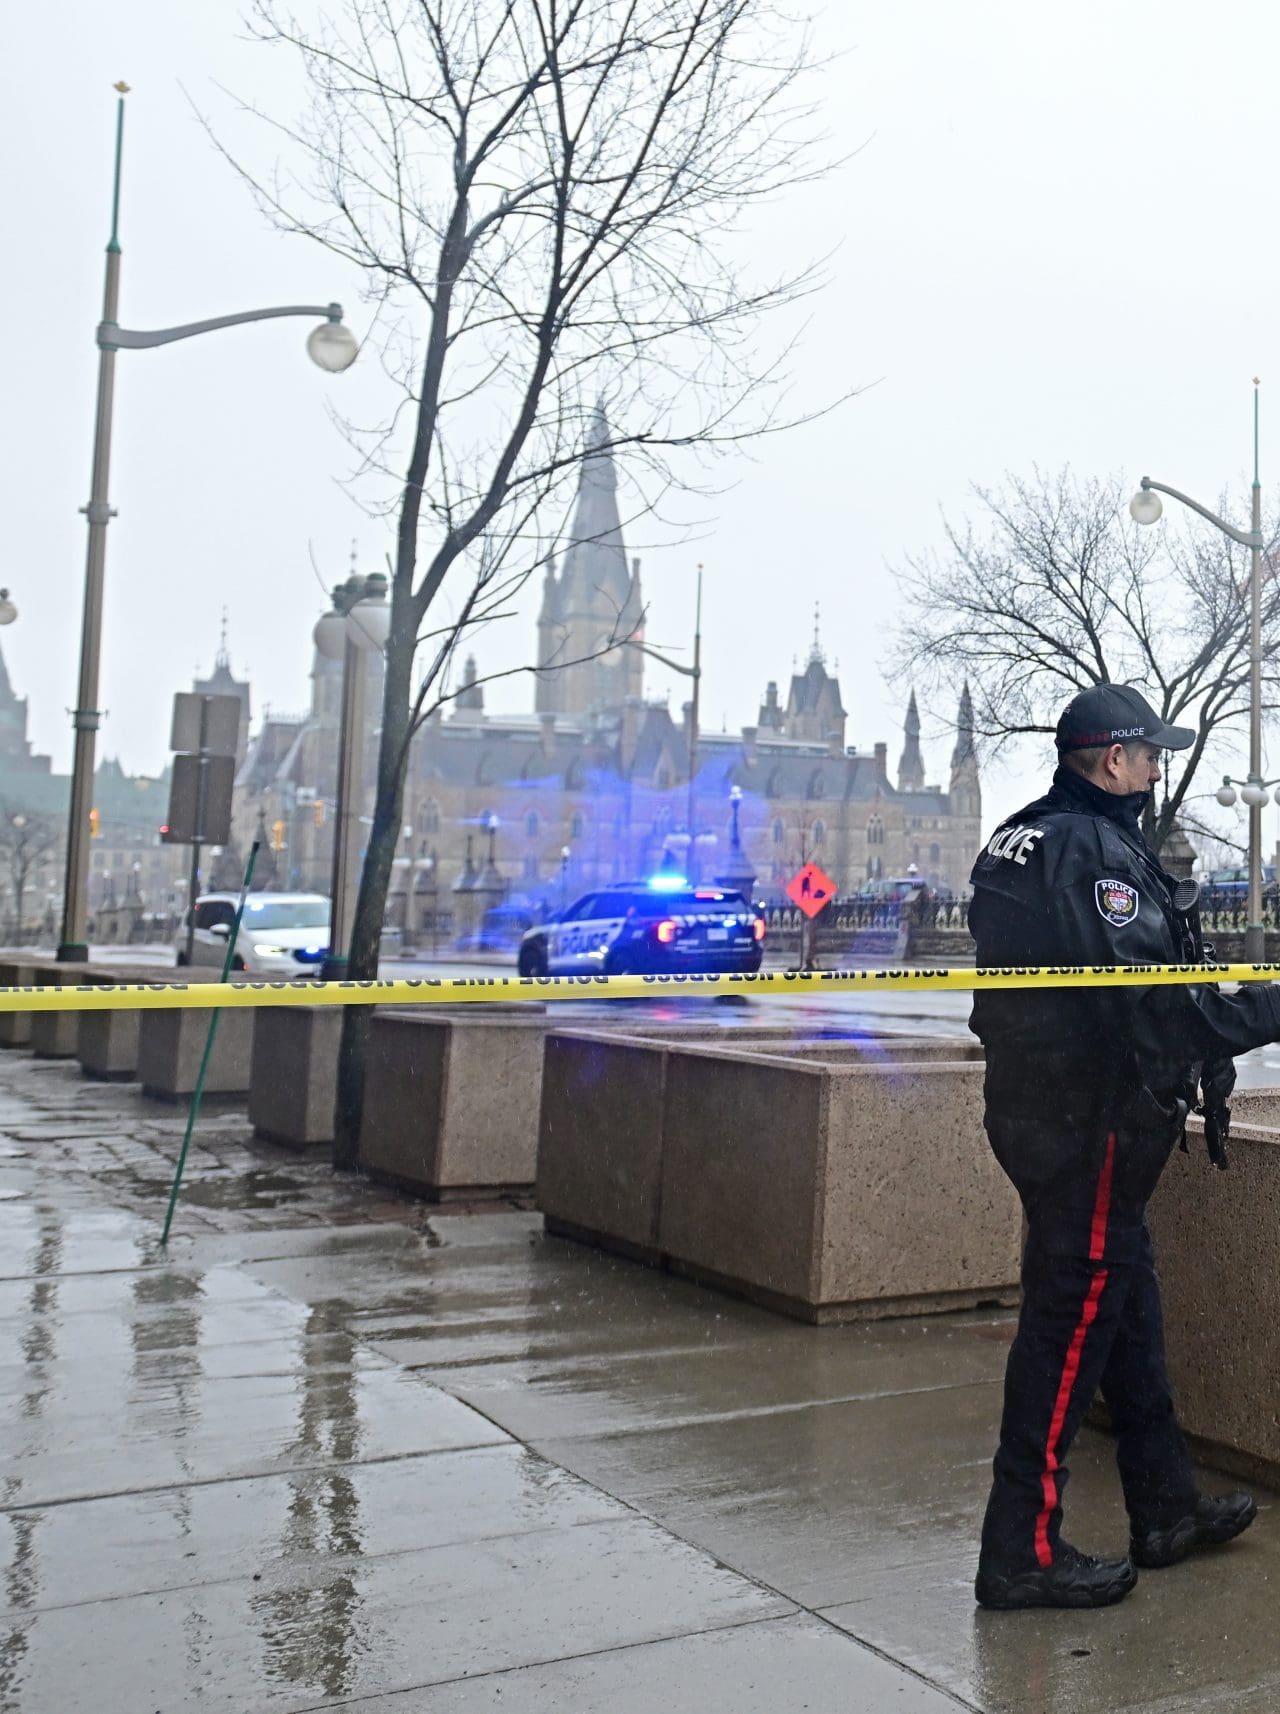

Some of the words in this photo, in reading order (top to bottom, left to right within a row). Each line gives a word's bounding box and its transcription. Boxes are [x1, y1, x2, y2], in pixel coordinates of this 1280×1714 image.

[1111, 727, 1145, 740] POLICE
[1101, 882, 1134, 897] POLICE
[561, 931, 609, 953] POLICE
